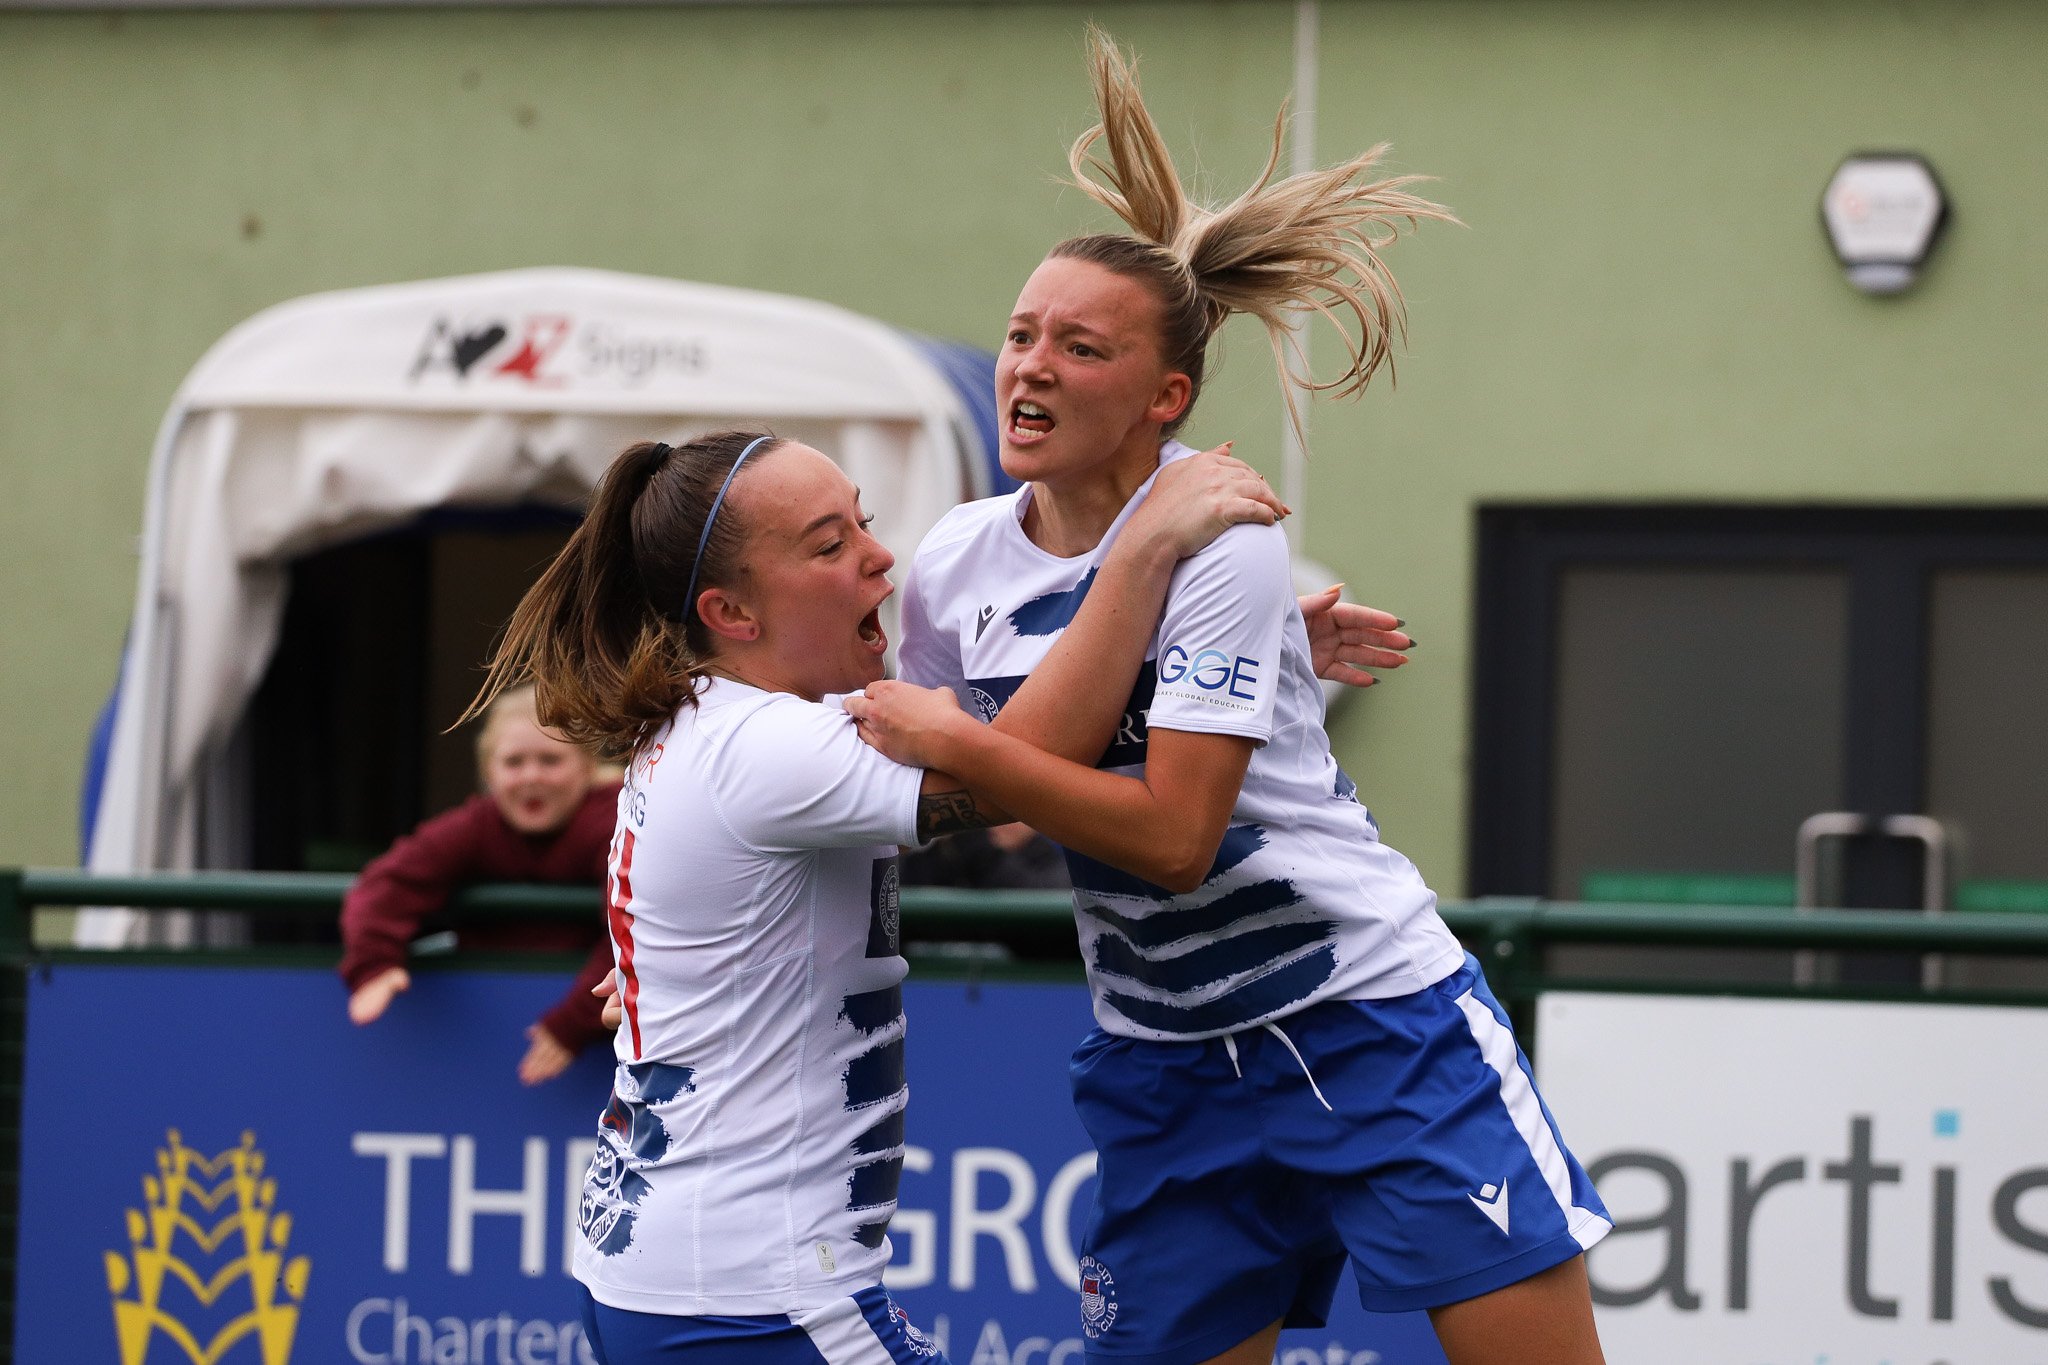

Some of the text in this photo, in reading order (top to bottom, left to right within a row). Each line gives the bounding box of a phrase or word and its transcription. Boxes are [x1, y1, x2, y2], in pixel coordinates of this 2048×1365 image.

[580, 321, 710, 392] Signs
[1160, 644, 1260, 701] GGE
[1175, 690, 1206, 703] GLOBAL
[1209, 698, 1256, 713] EDUCATION
[1096, 1262, 1114, 1286] CITY
[1100, 1302, 1119, 1332] CLUB
